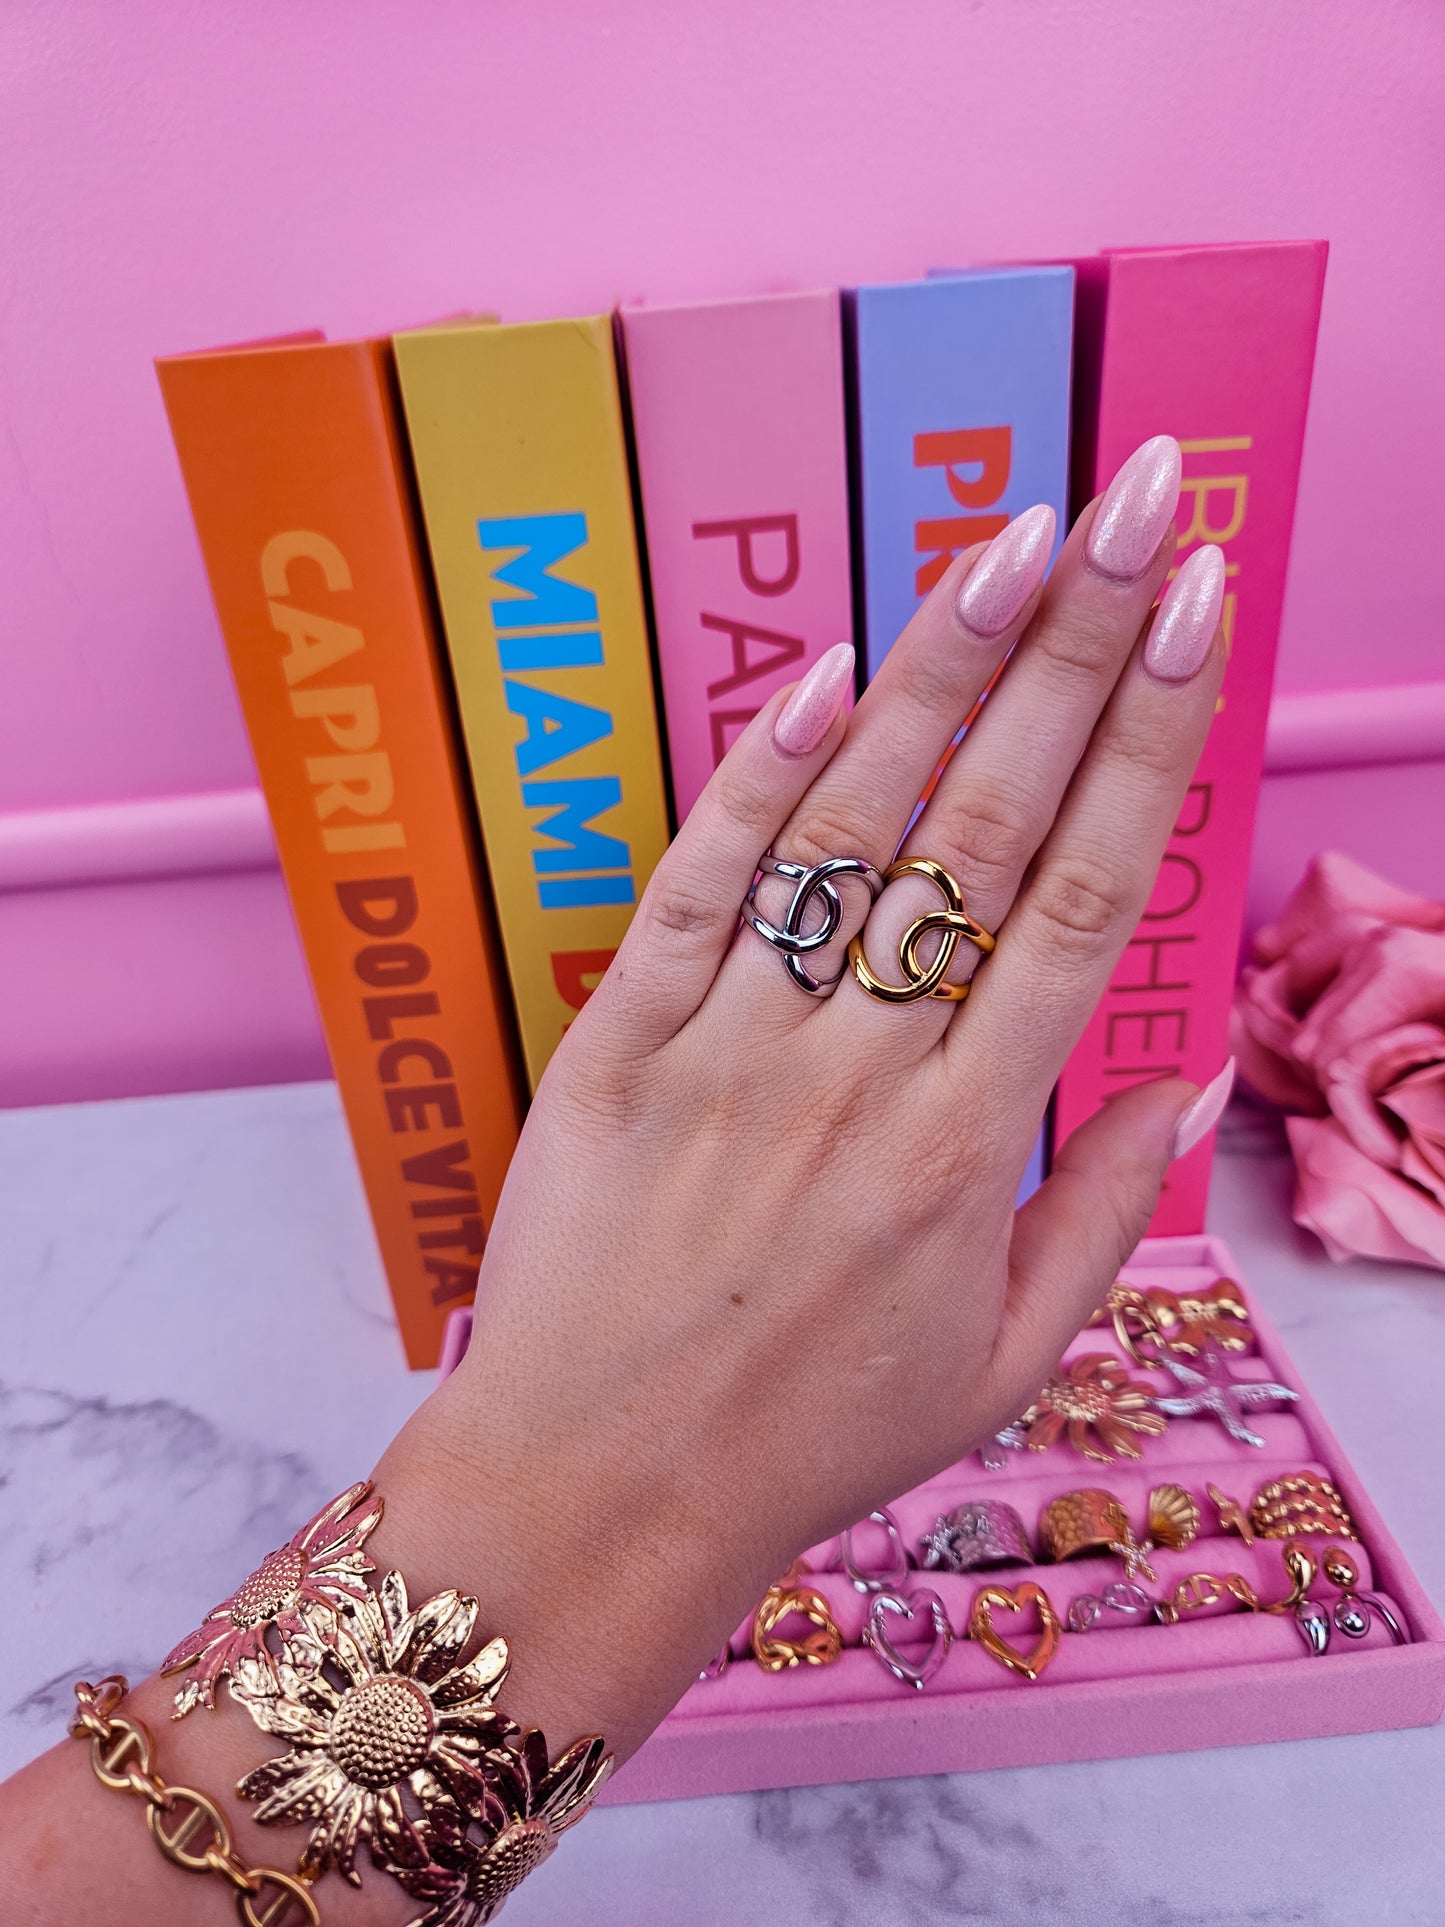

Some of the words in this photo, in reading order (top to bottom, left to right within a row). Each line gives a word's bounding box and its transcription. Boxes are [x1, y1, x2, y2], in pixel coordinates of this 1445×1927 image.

[260, 530, 407, 854] CAPRI
[334, 876, 466, 1135] DOLCE
[401, 1139, 486, 1308] VITA
[477, 511, 637, 910] MIAMI
